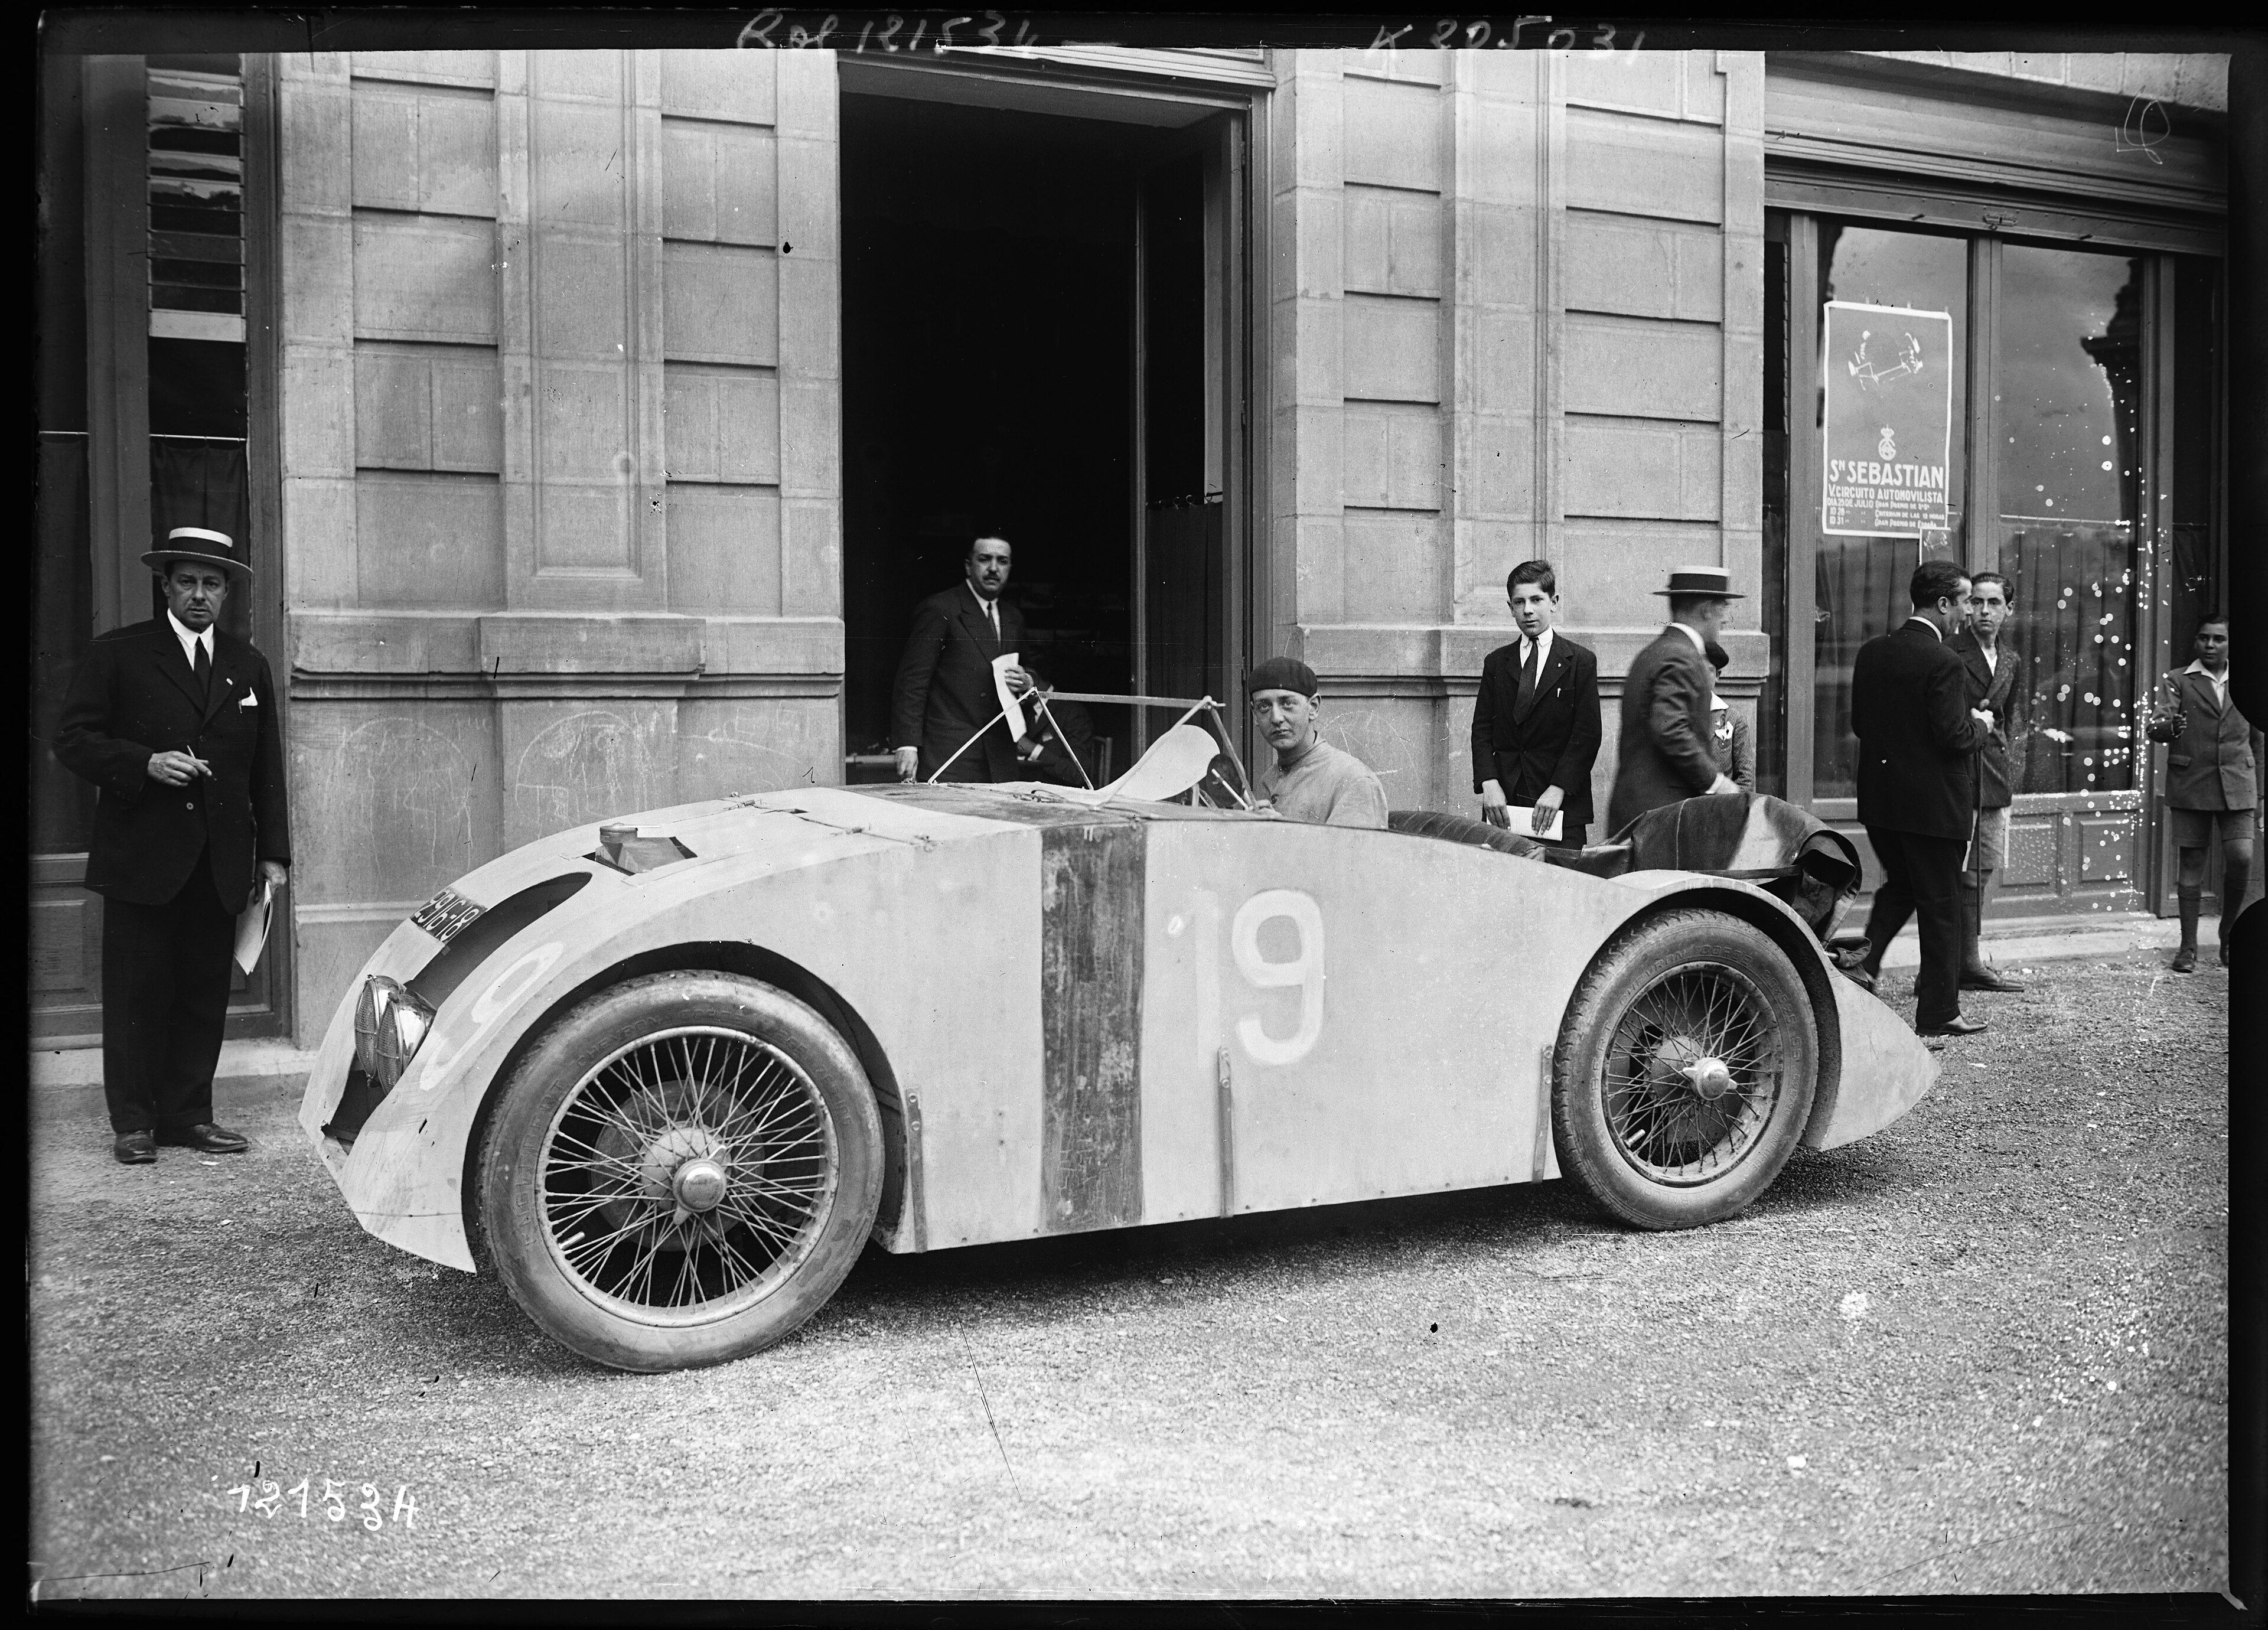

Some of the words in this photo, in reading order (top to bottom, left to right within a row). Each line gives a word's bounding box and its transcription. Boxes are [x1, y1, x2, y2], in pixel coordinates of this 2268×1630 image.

[1847, 461, 1943, 488] SEBASTIAN
[1854, 498, 1873, 508] JULIO
[1877, 488, 1943, 503] AUTOMOVILISTA
[1186, 889, 1325, 1065] 19
[227, 1476, 421, 1531] 121534
